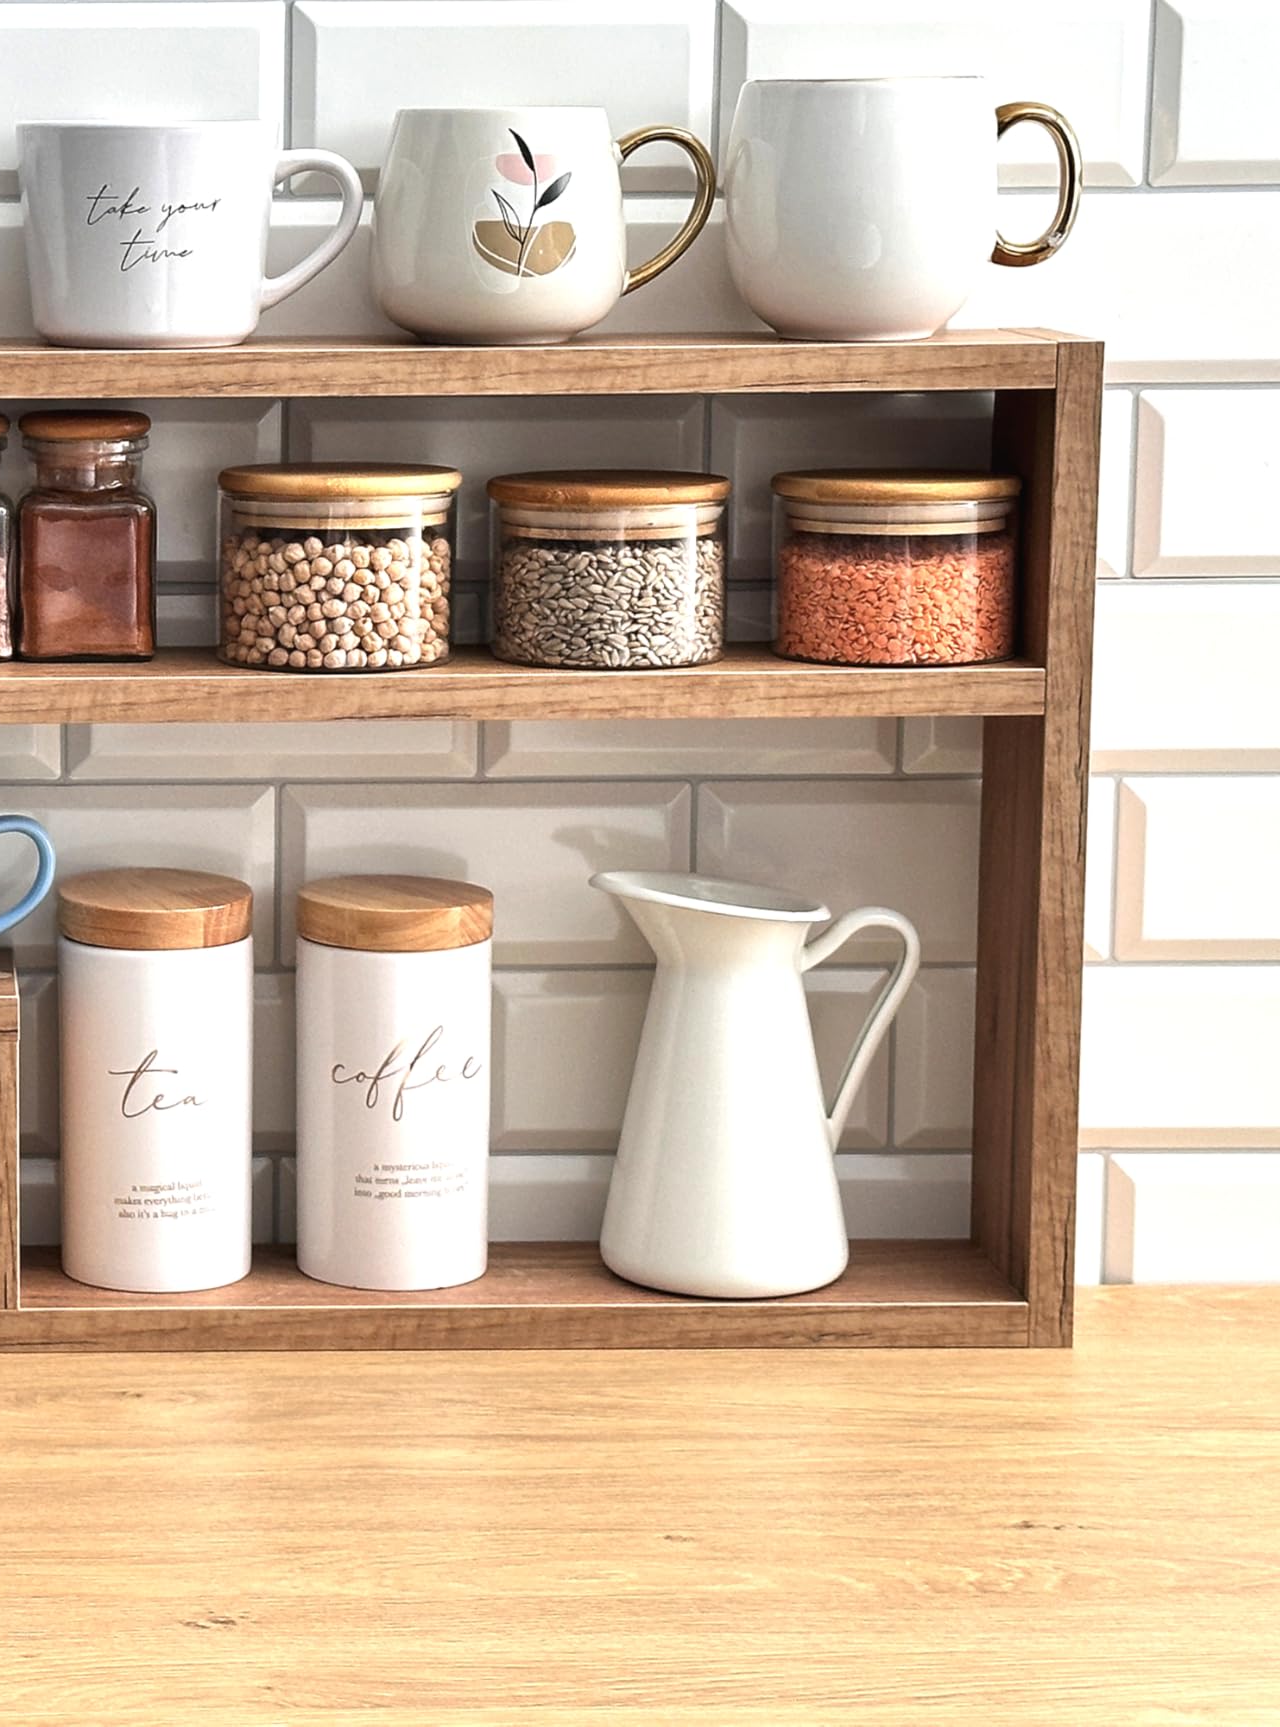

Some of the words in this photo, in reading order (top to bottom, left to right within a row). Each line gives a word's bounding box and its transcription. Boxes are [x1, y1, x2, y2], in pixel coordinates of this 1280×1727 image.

[85, 184, 151, 226] take
[156, 198, 221, 233] your
[120, 228, 194, 272] time
[107, 1049, 208, 1119] tea
[331, 1024, 482, 1122] coffee
